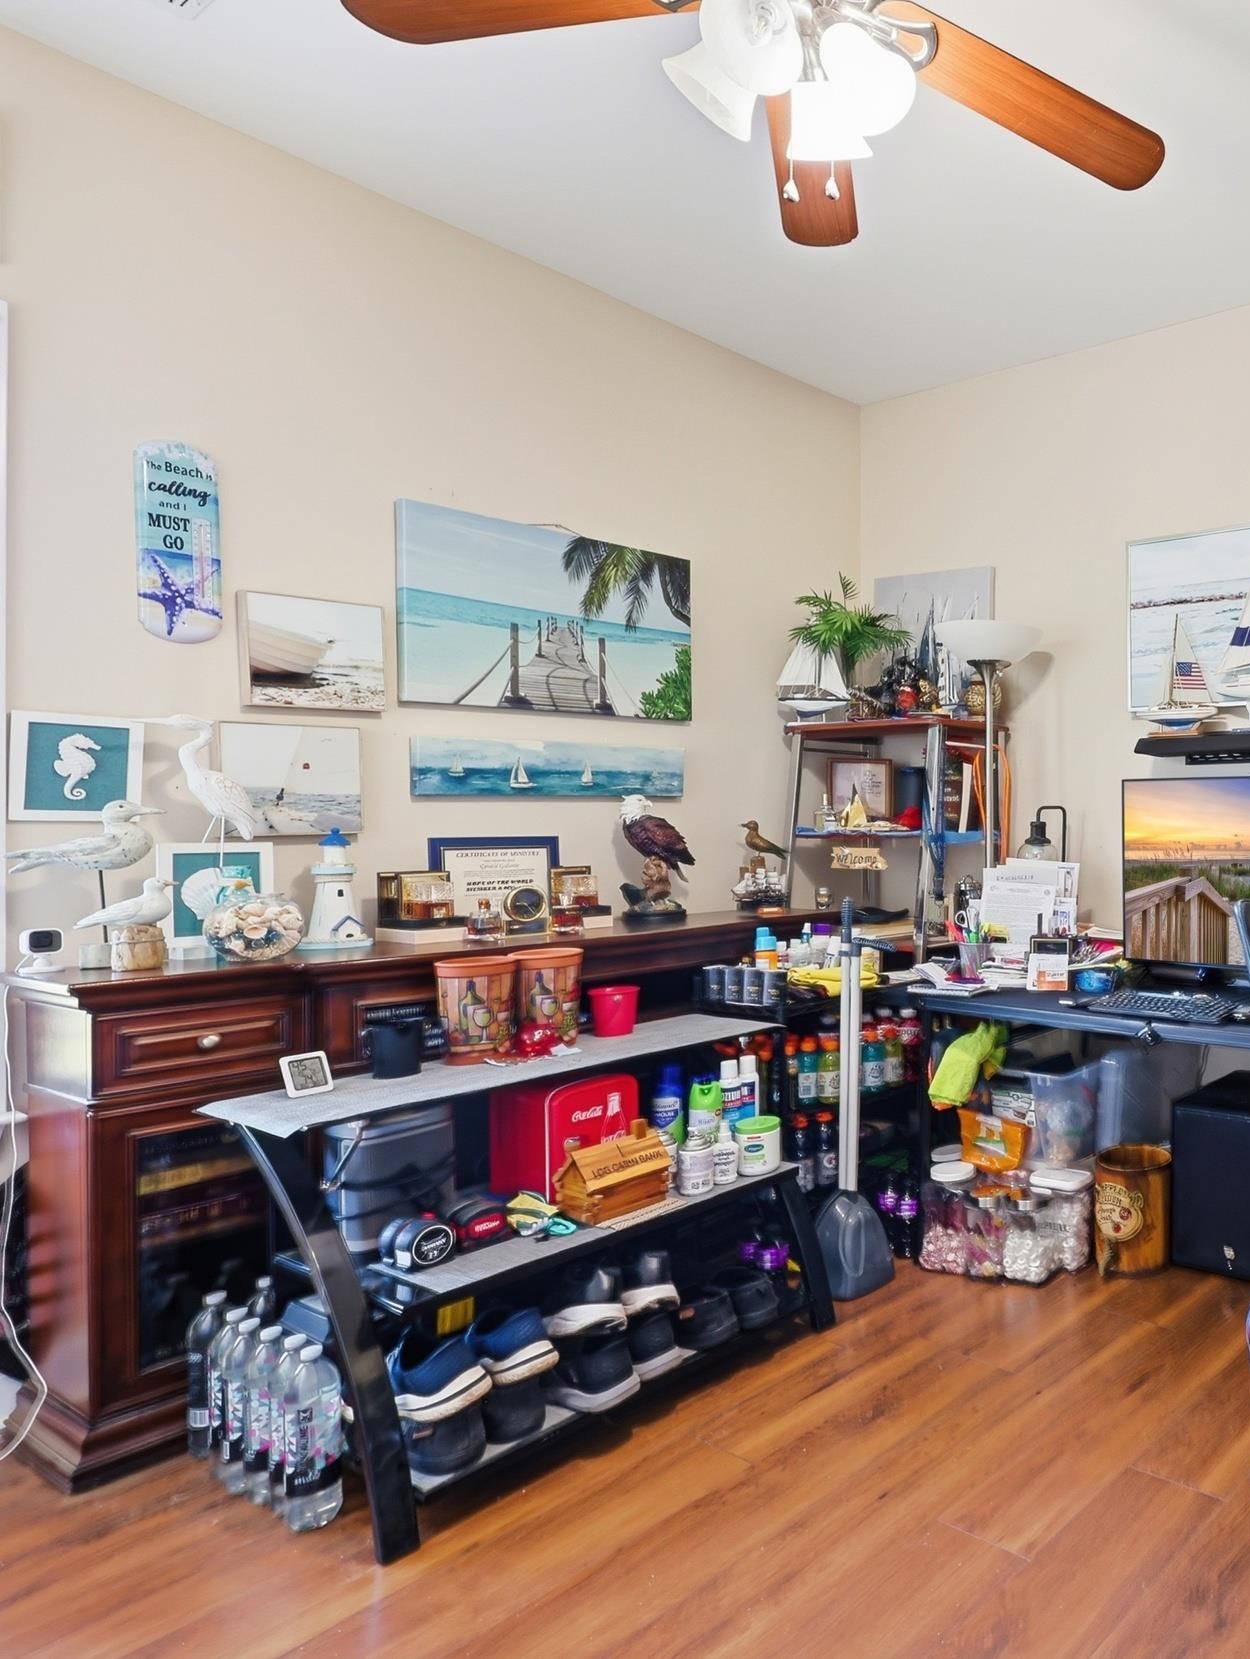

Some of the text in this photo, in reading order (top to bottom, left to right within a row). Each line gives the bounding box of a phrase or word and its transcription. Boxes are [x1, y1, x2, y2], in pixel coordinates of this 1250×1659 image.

[164, 461, 203, 480] Beach
[148, 481, 211, 507] calling
[158, 501, 180, 510] and
[147, 512, 190, 532] MUST
[162, 535, 184, 550] GO
[591, 1150, 663, 1178] LOG CABIN BANK
